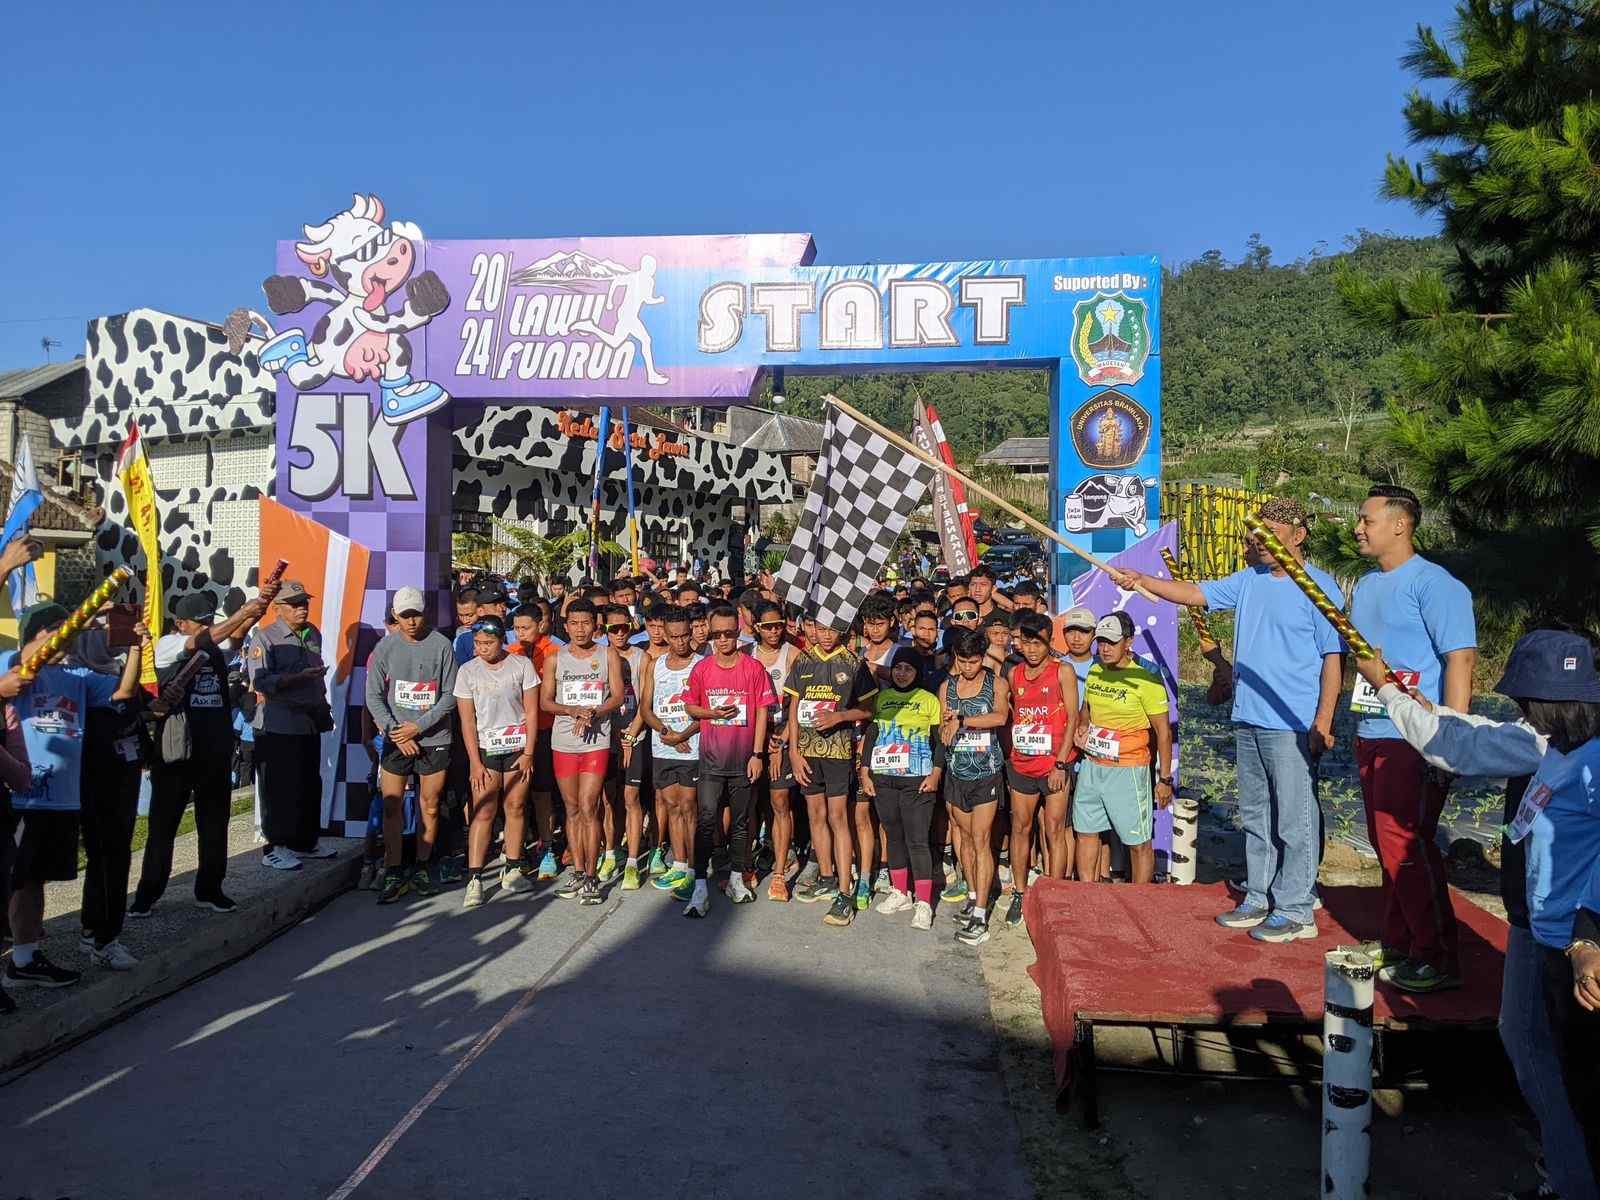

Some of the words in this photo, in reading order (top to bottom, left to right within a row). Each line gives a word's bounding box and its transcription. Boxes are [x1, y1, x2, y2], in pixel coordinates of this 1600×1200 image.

[464, 252, 506, 312] 20
[1053, 275, 1120, 292] Suported
[1122, 273, 1141, 289] By
[508, 293, 608, 337] LAWU
[698, 274, 1027, 353] START
[454, 317, 496, 376] 24
[496, 340, 637, 380] FUNRUN
[1076, 400, 1114, 431] UNIVERSITAS
[1114, 400, 1145, 430] BRAWIJAYA
[288, 392, 417, 500] 5K
